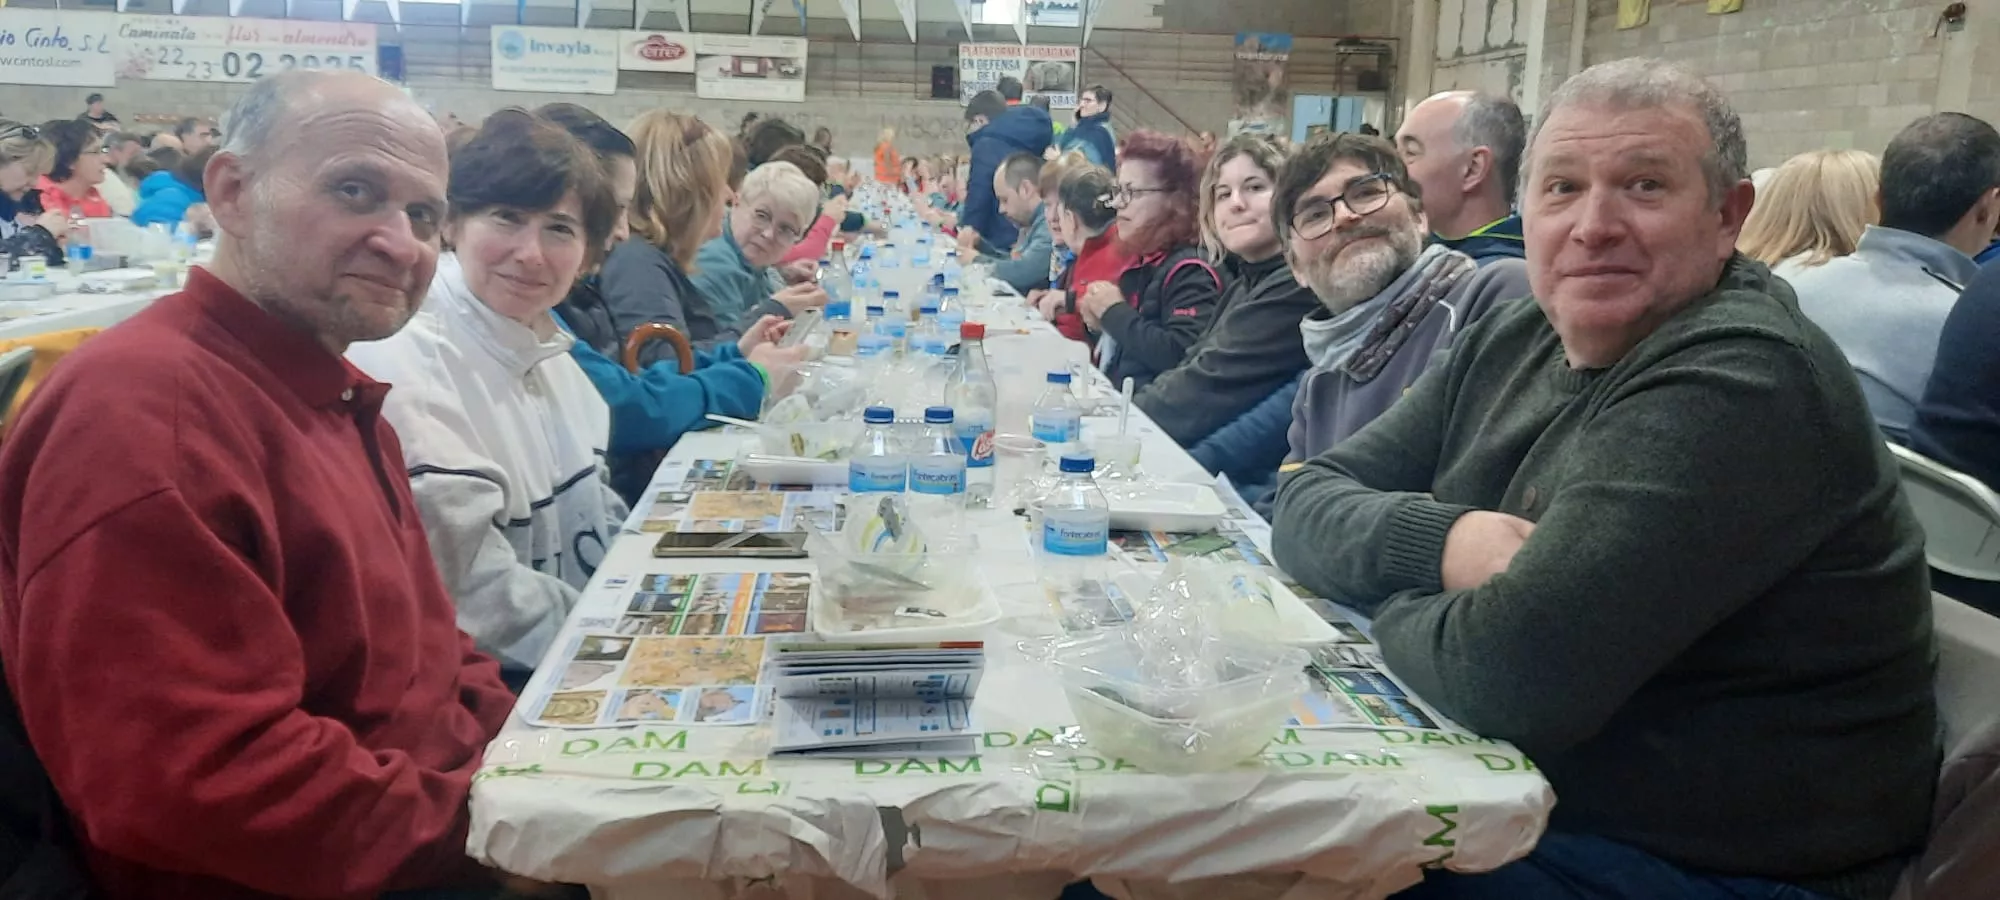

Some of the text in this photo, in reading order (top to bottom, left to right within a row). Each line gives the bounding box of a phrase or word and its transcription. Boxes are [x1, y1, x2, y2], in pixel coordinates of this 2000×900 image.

[158, 46, 183, 66] 22
[530, 39, 592, 57] Invayla
[561, 730, 688, 756] DAM
[1377, 729, 1497, 746] DAM
[632, 759, 766, 780] DAM
[855, 755, 982, 775] DAM
